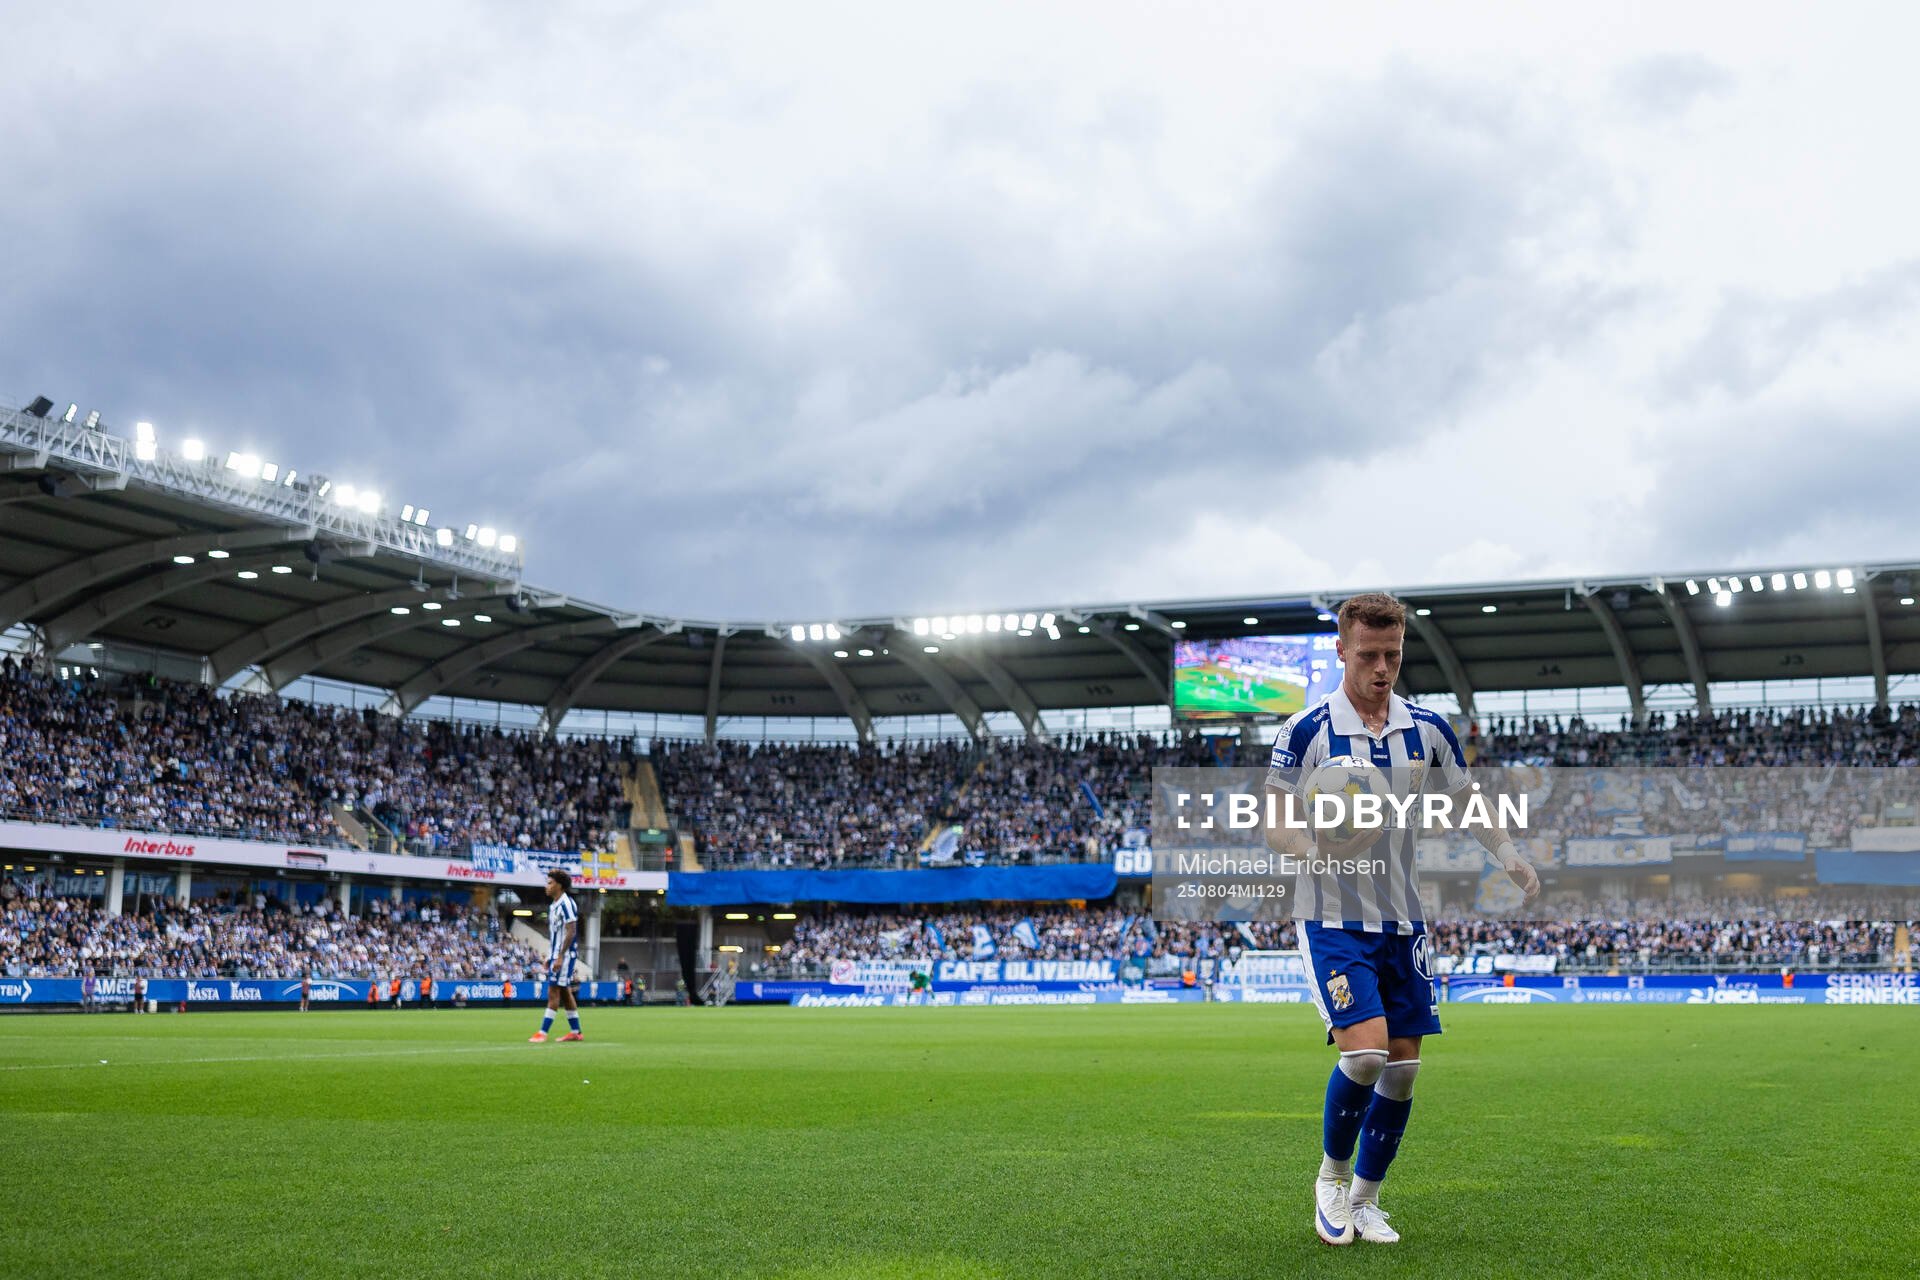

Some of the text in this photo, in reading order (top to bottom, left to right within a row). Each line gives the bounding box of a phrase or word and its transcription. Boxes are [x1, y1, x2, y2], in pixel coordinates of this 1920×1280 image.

[124, 837, 195, 857] Interbus
[572, 875, 627, 887] nterbus
[939, 962, 999, 982] CAFE
[1005, 961, 1116, 982] OLIVEDAL
[309, 986, 339, 1000] uebid
[471, 982, 517, 998] GÖTEBG
[1825, 987, 1920, 1004] SERNEKE
